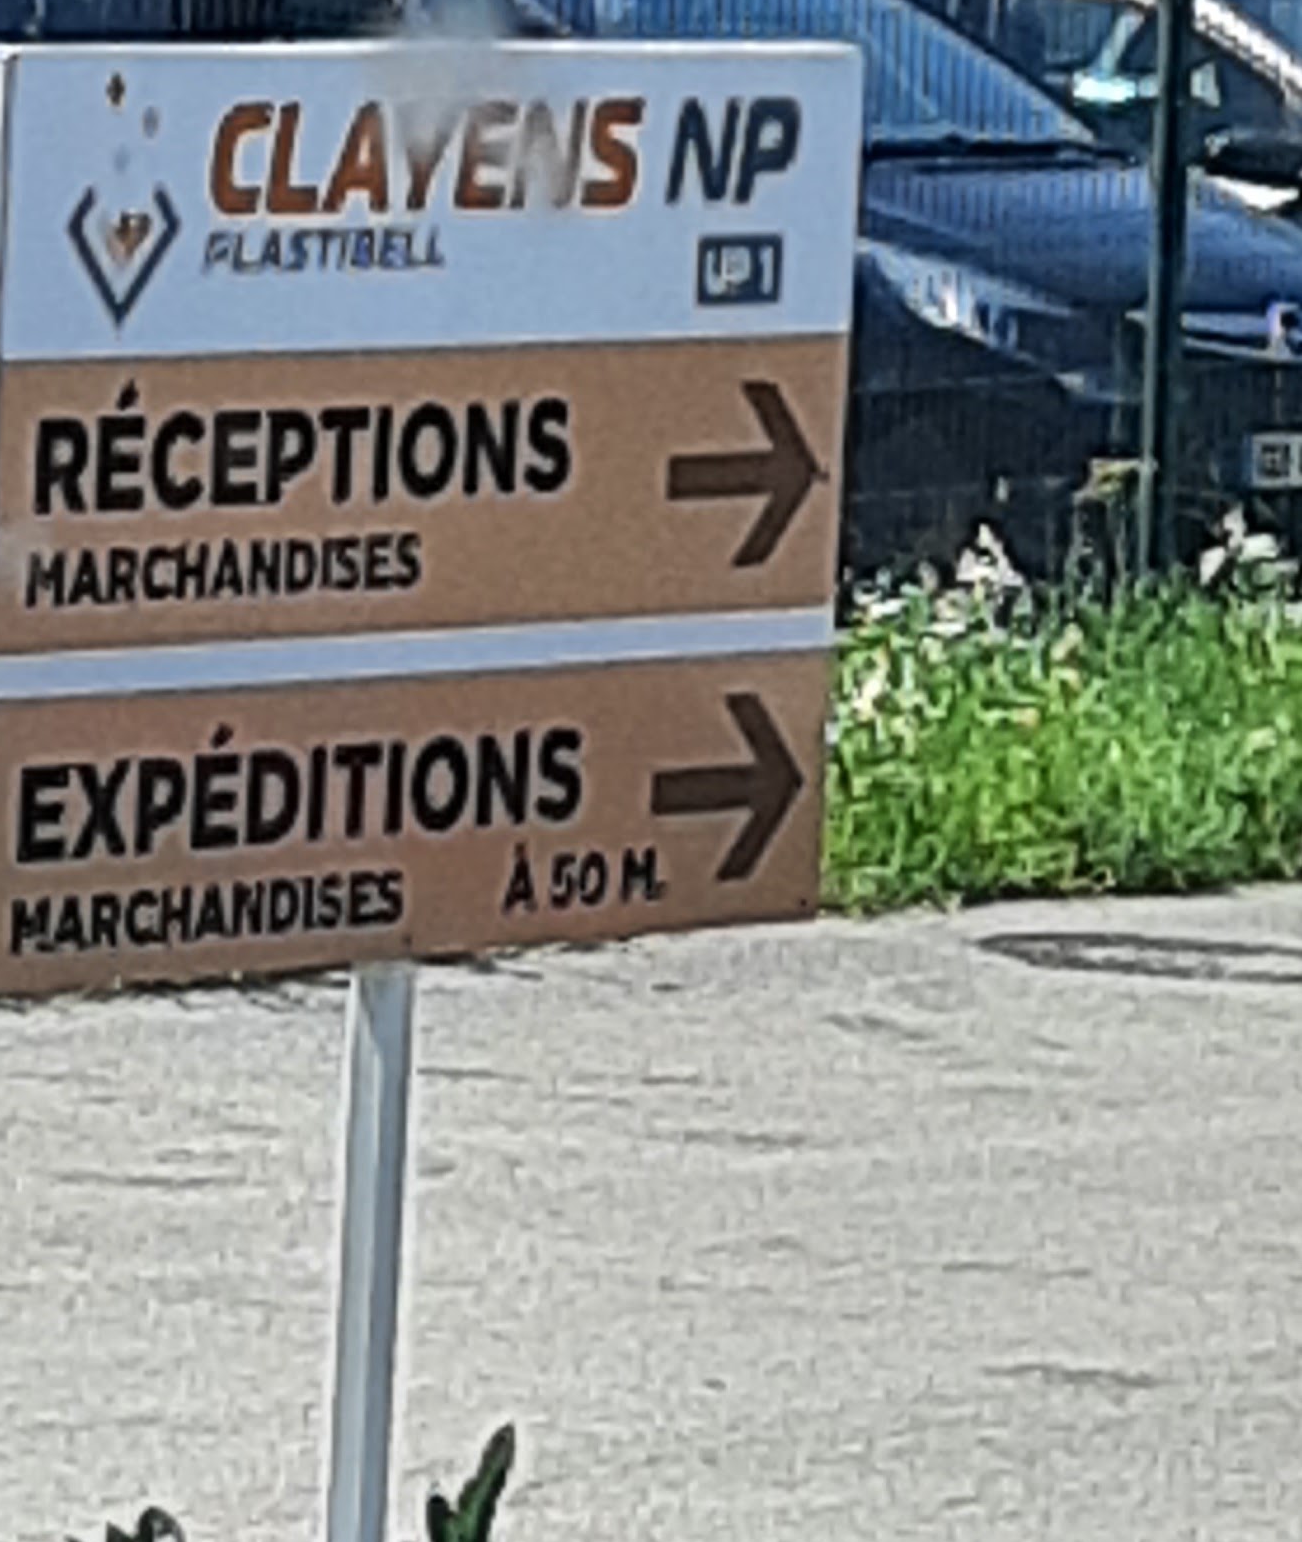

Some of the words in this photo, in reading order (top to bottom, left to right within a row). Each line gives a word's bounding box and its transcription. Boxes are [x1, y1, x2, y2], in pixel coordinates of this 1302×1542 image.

[209, 96, 646, 215] CLAYENS
[665, 96, 801, 207] NP
[201, 227, 446, 275] PLASTIBELL
[34, 380, 571, 515] RÉCEPTIONS
[24, 532, 422, 607] MARCHANDISES
[16, 724, 584, 863] EXPÉDITIONS
[10, 871, 404, 954] MARCHANDISES
[551, 850, 609, 908] 50
